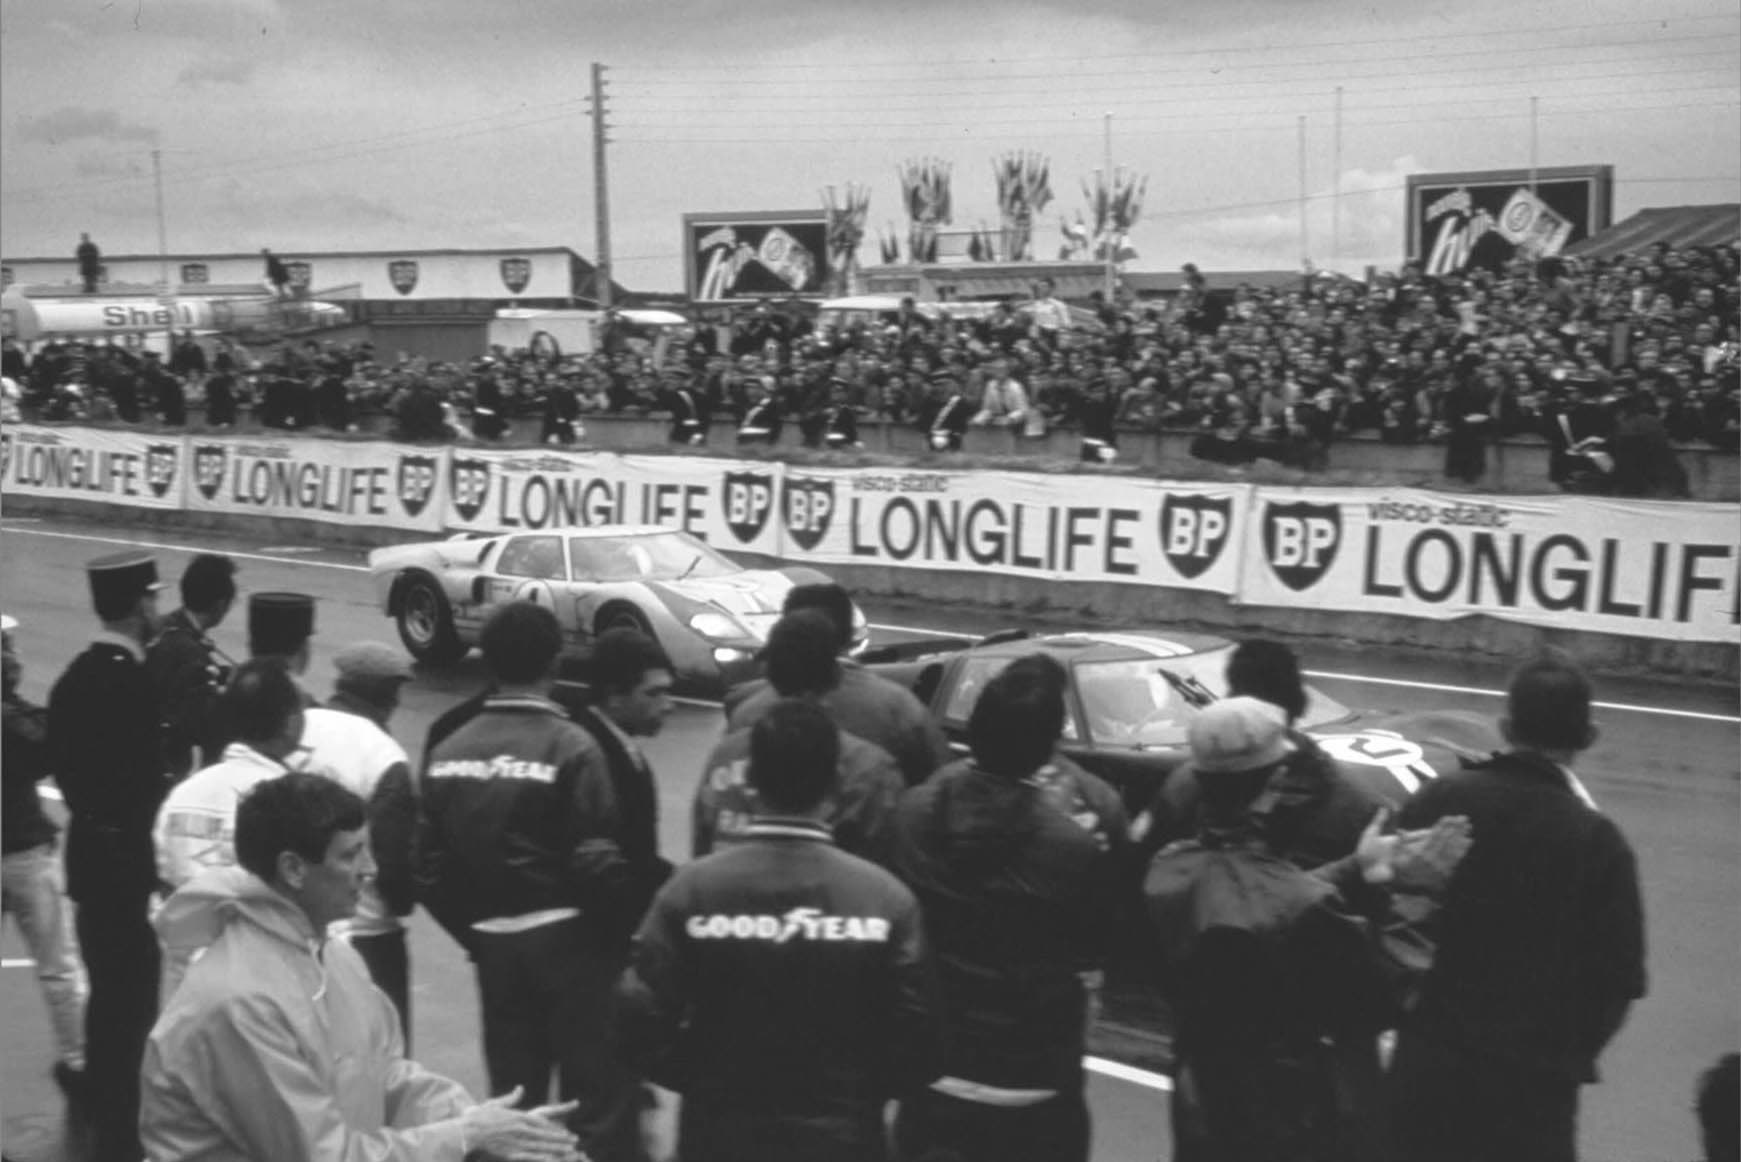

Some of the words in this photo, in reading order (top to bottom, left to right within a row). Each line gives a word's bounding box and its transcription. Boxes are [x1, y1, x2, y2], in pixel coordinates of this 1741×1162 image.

[16, 446, 138, 496] LONGLIFE
[233, 458, 389, 515] LONGLIFE
[730, 483, 770, 525] BP
[788, 489, 830, 532] BP
[850, 495, 1141, 576] LONGLIFE
[1167, 506, 1226, 558] BP
[1271, 515, 1336, 568] BP
[1363, 524, 1741, 626] LONGLIF
[684, 906, 890, 944] GOODYEAR
